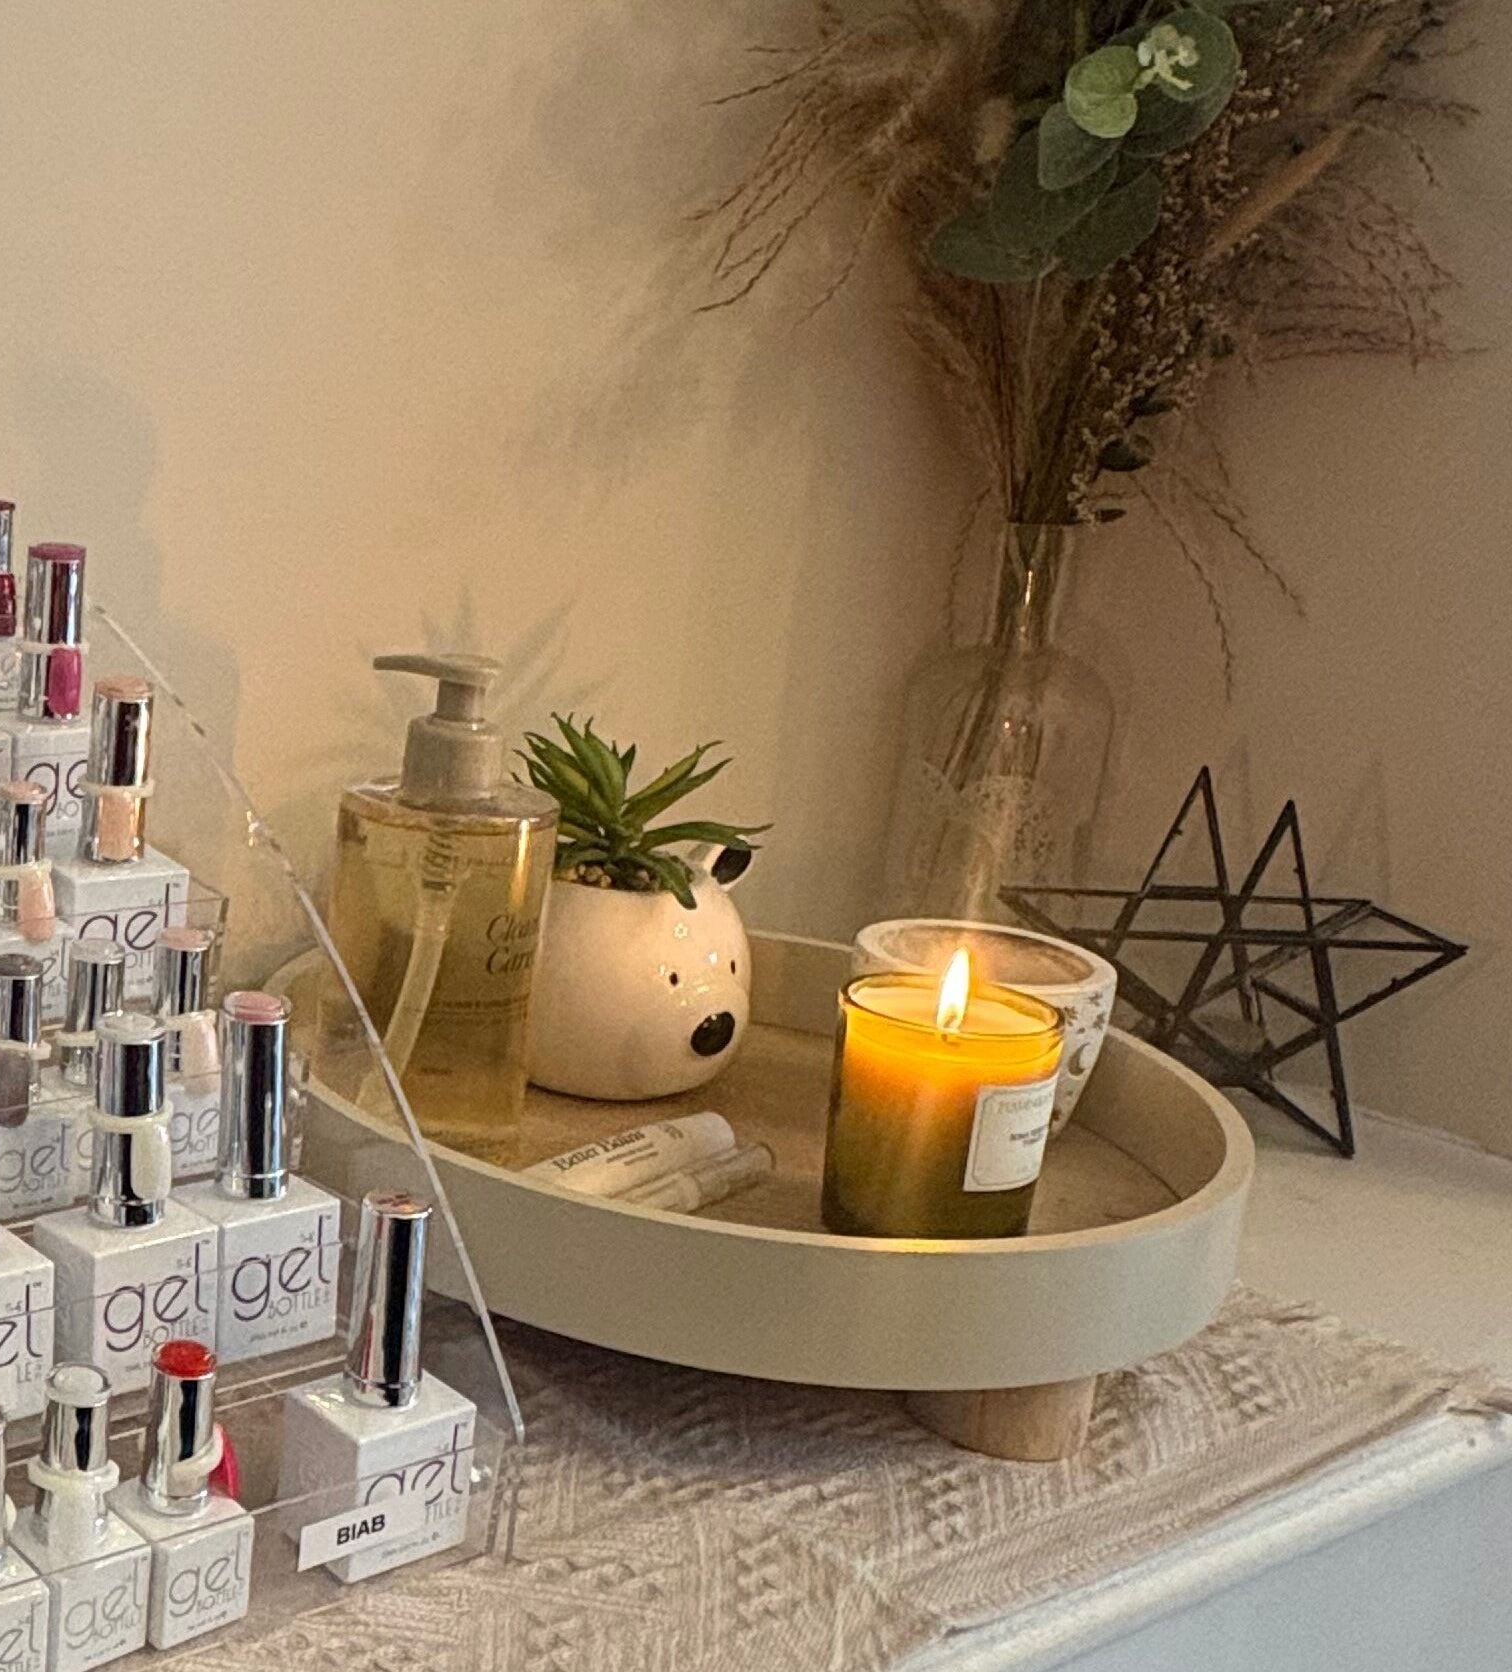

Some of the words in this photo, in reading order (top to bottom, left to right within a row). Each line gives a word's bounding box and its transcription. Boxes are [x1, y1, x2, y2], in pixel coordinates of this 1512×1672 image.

[104, 1243, 209, 1352] gel
[231, 1214, 331, 1322] gel
[169, 1530, 245, 1618] gel
[336, 1513, 386, 1546] BIAB
[64, 1558, 141, 1650] gel
